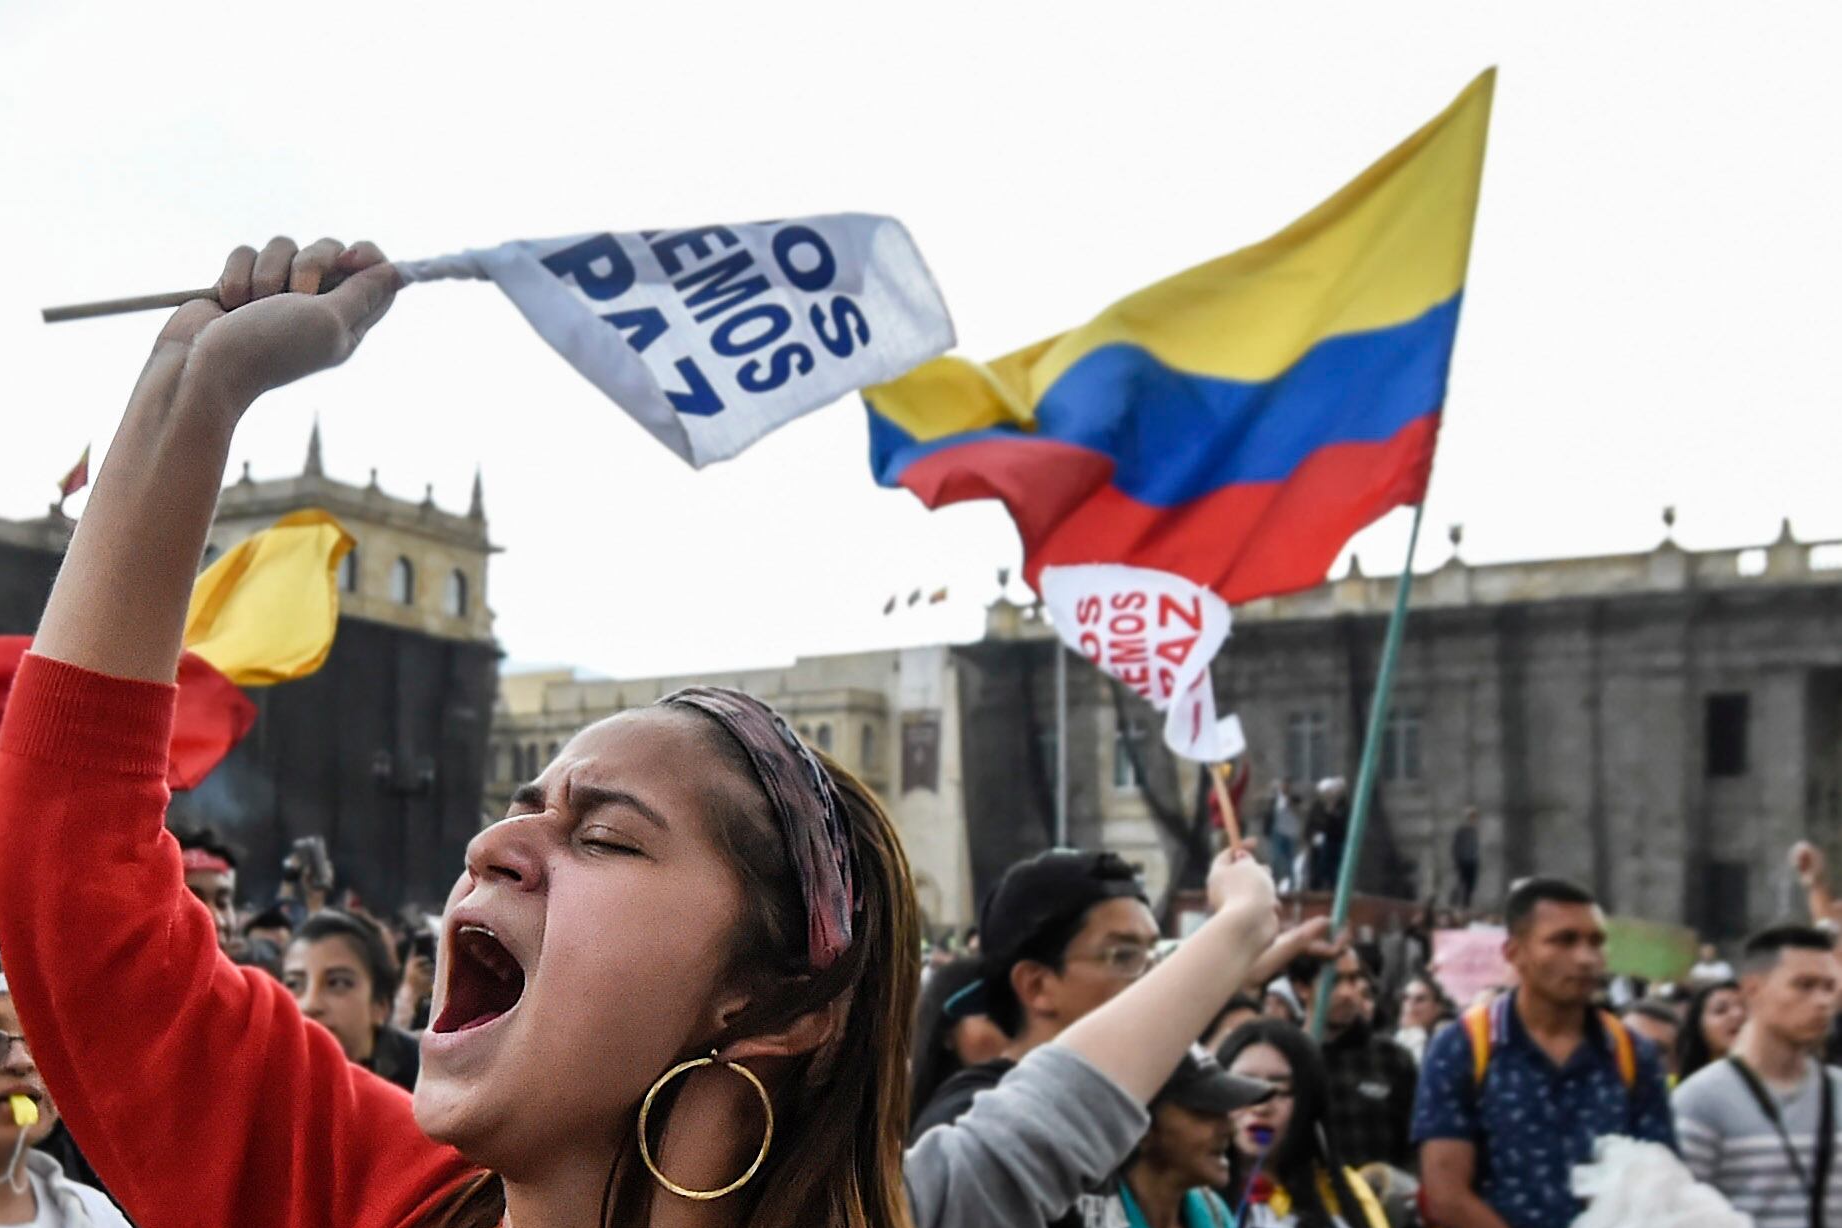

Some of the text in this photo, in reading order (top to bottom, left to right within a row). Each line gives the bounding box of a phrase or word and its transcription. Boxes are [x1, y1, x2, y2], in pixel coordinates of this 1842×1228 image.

[646, 224, 816, 394] EMOS
[770, 223, 871, 359] OS
[1076, 595, 1102, 666] OS
[1108, 590, 1150, 697] EMOS
